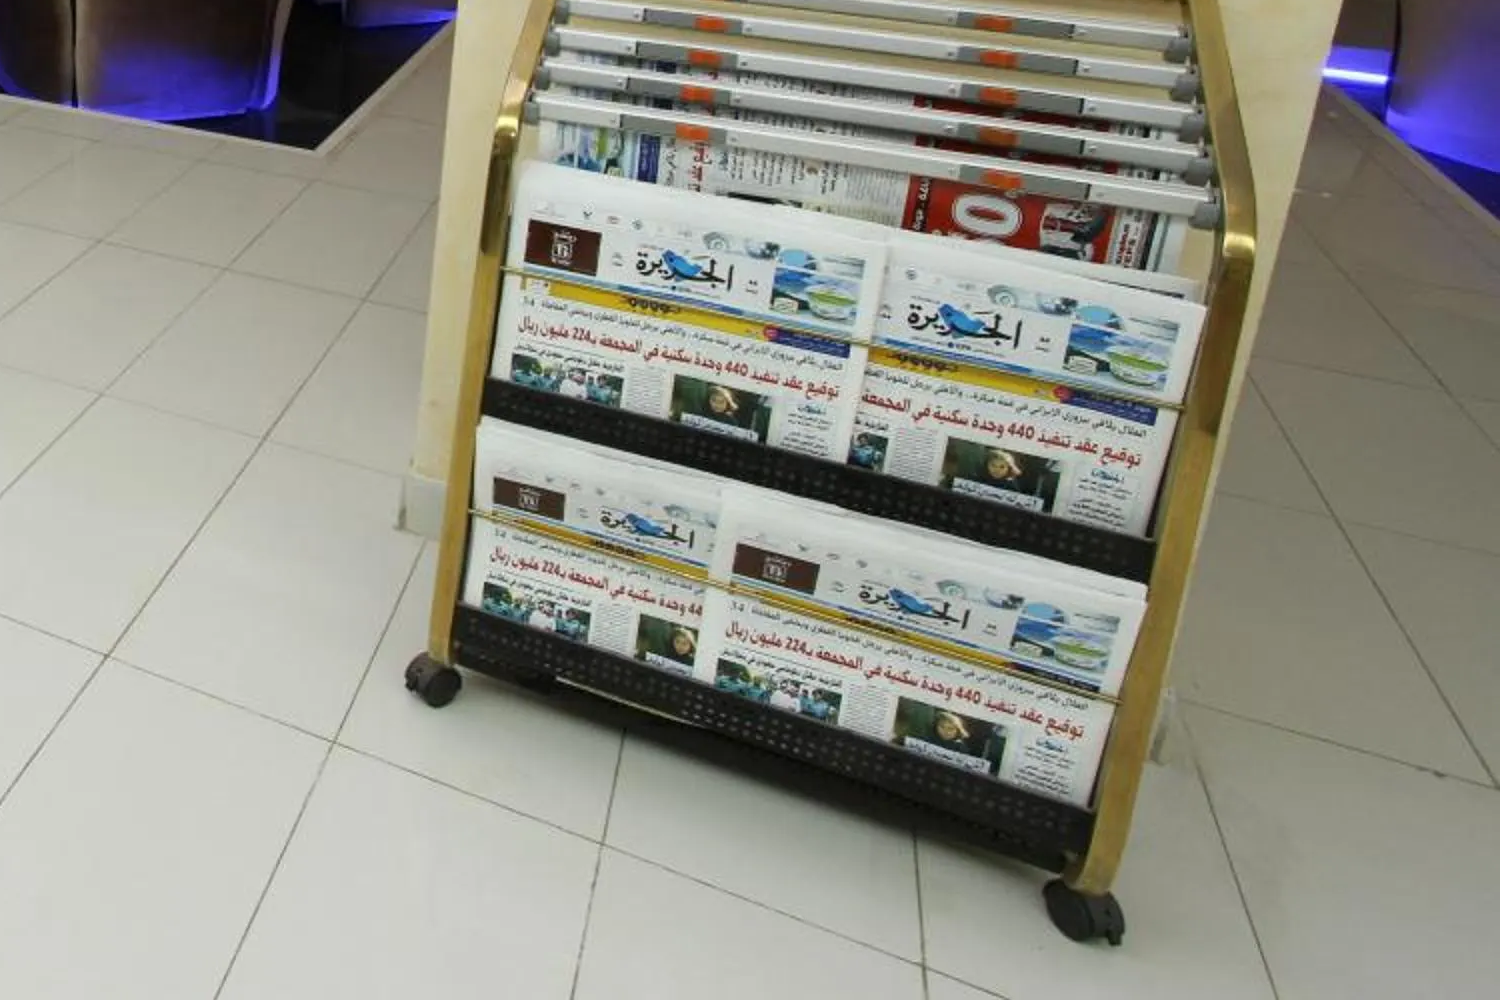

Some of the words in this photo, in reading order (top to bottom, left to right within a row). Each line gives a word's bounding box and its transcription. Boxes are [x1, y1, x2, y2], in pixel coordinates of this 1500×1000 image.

[518, 315, 539, 336] ريال
[540, 323, 569, 341] مليون
[600, 333, 643, 354] المجمعة
[644, 343, 659, 361] في
[662, 345, 692, 364] سكنية
[694, 351, 721, 375] وحدة
[725, 360, 748, 377] 440
[750, 367, 779, 385] تنفيذ
[782, 376, 803, 391] عقد
[805, 380, 840, 400] توقيع
[861, 389, 911, 412] المجمعة
[912, 403, 930, 421] في
[932, 405, 968, 425] سكنية
[971, 413, 1004, 438] وحدة
[1008, 422, 1035, 439] 440
[1037, 429, 1071, 448] تنفيذ
[1074, 437, 1098, 454] عقد
[1100, 447, 1141, 469] توقيع
[609, 583, 625, 599] في
[687, 603, 704, 617] 44
[725, 619, 749, 643] ريال
[750, 628, 783, 648] مليون
[815, 645, 863, 671] المجمعة
[864, 664, 882, 679] في
[884, 665, 918, 687] سكنية
[920, 675, 953, 701] وحدة
[955, 686, 981, 704] 440
[984, 696, 1017, 715] تنفيذ
[1019, 709, 1044, 724] عقد
[1045, 717, 1085, 740] توقيع
